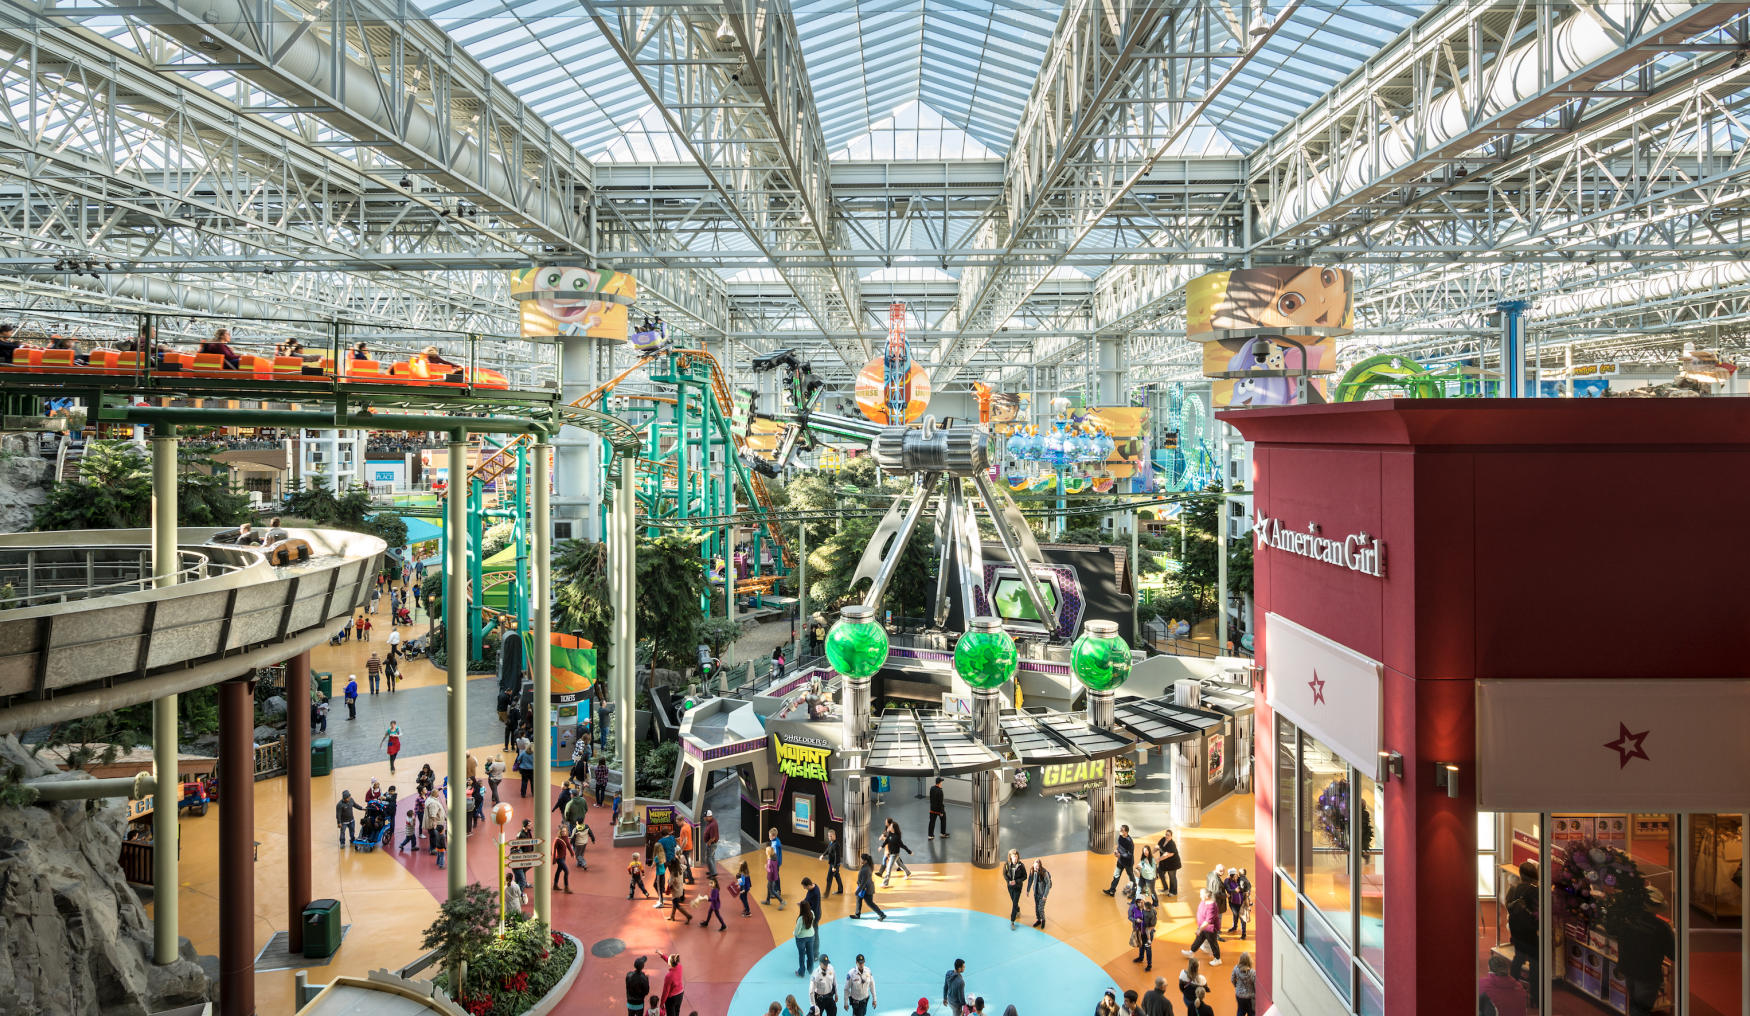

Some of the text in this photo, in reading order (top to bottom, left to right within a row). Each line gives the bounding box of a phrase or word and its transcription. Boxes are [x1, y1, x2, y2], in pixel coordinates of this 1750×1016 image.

[1600, 364, 1615, 374] GOLF
[1270, 518, 1383, 577] American Girl
[560, 694, 576, 702] TICKETS
[774, 733, 831, 770] MUTANT
[784, 734, 828, 746] SHREDDER'S
[779, 758, 829, 782] MASHER
[1043, 759, 1105, 786] GEAR
